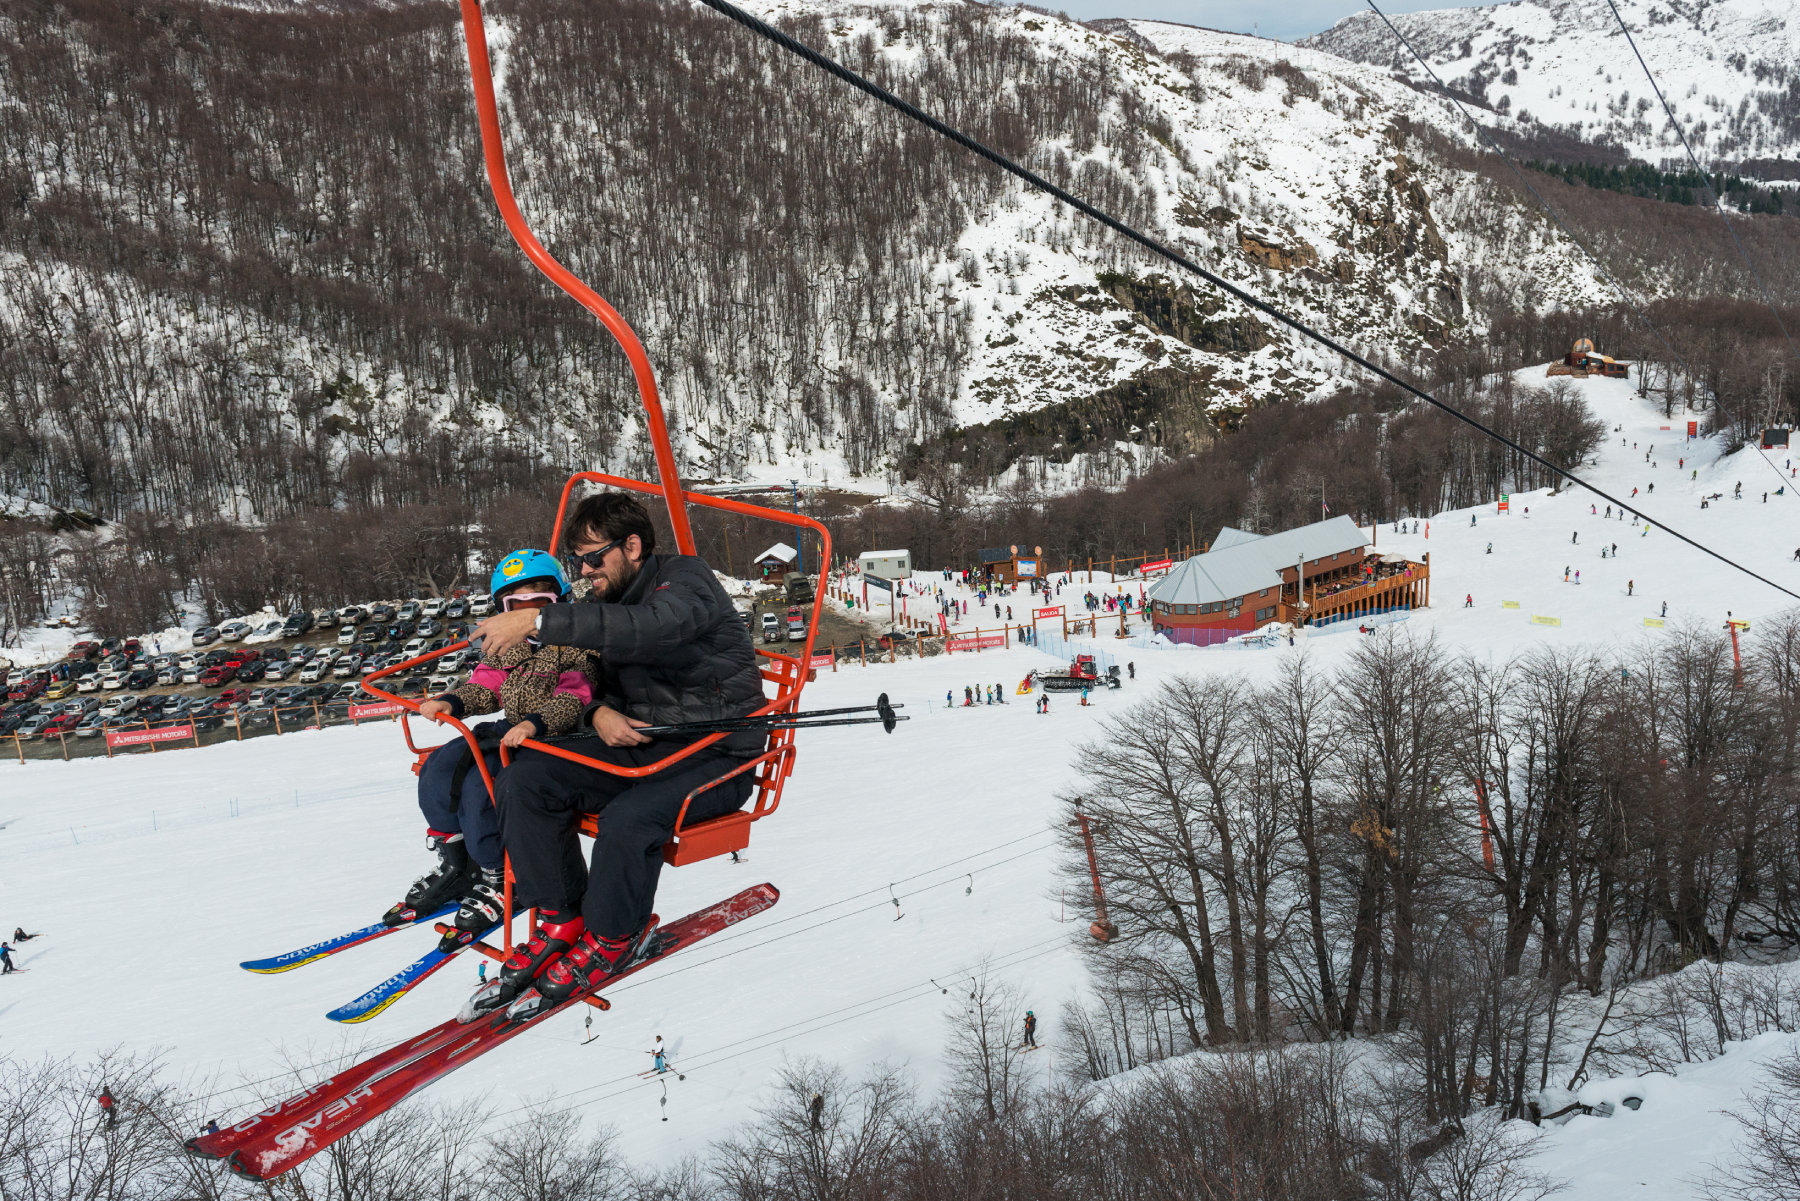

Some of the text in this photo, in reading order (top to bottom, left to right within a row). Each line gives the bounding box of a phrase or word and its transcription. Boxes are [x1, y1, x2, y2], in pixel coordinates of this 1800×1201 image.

[956, 640, 981, 649] MITSUBISHI
[363, 705, 396, 716] MITSUBISHI
[123, 730, 188, 743] MITSUBISHI MOTORS
[724, 897, 774, 926] HEAD
[276, 929, 365, 962] SALOMON
[233, 1079, 334, 1133] HEAD
[274, 1086, 374, 1146] HEAD
